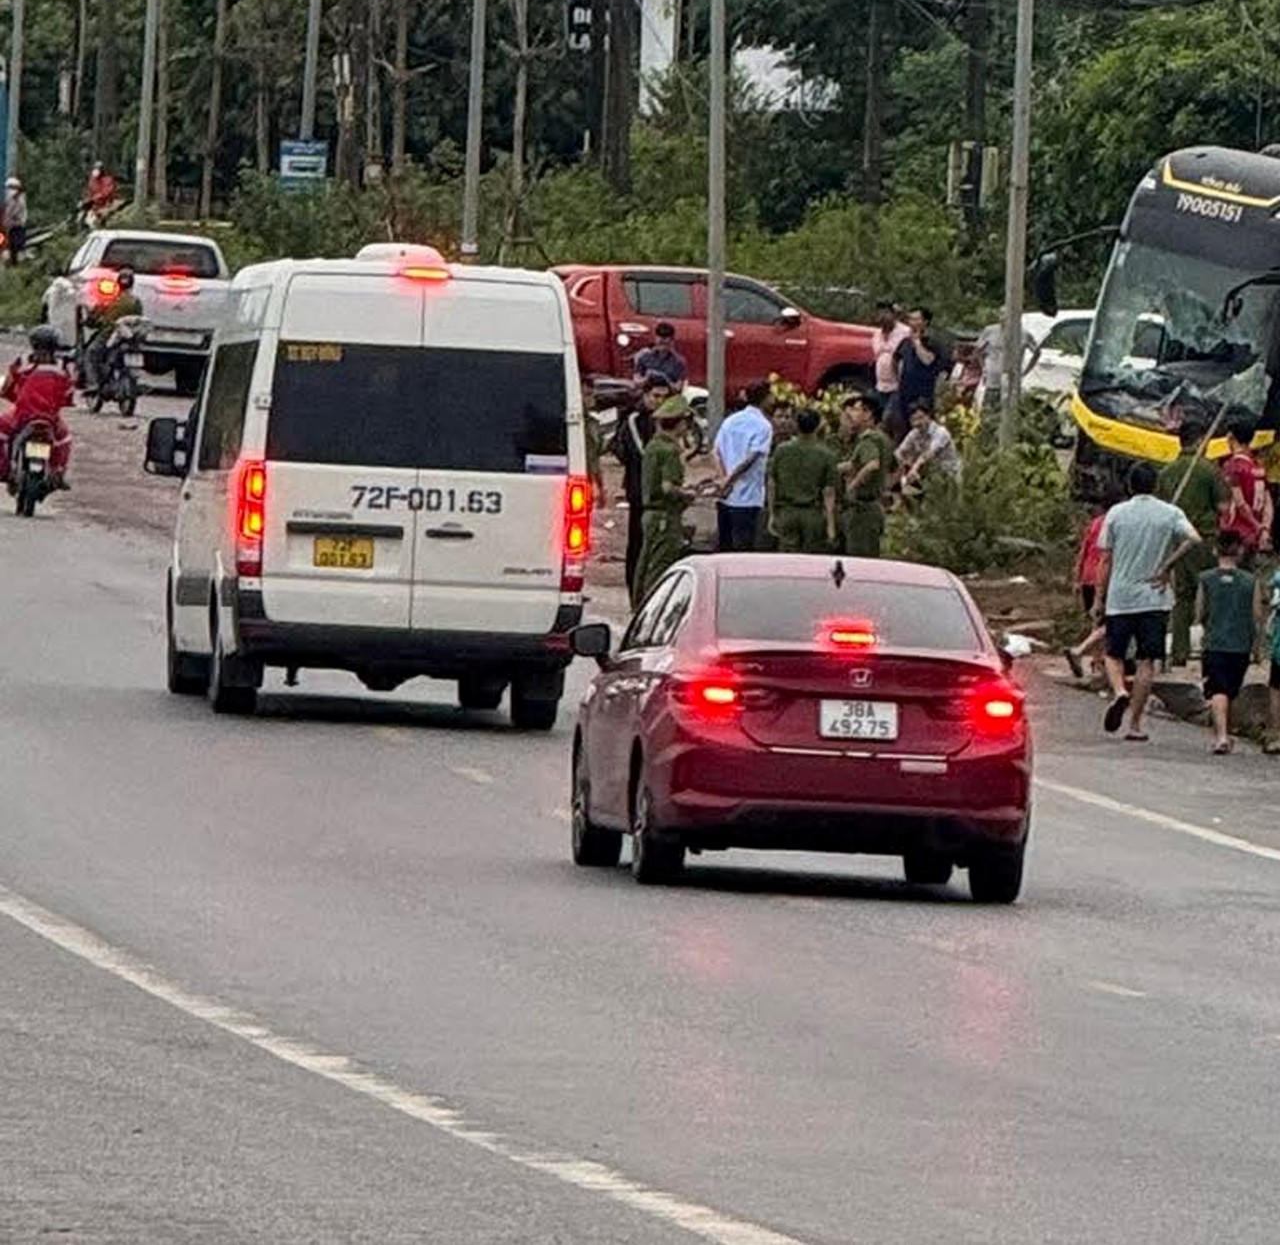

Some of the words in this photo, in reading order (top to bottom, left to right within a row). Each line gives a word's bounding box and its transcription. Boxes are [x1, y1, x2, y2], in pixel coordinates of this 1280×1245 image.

[1176, 193, 1243, 223] 19005151
[351, 486, 502, 515] 72F-001.63
[843, 702, 875, 718] 38A
[829, 719, 889, 736] 492.75
